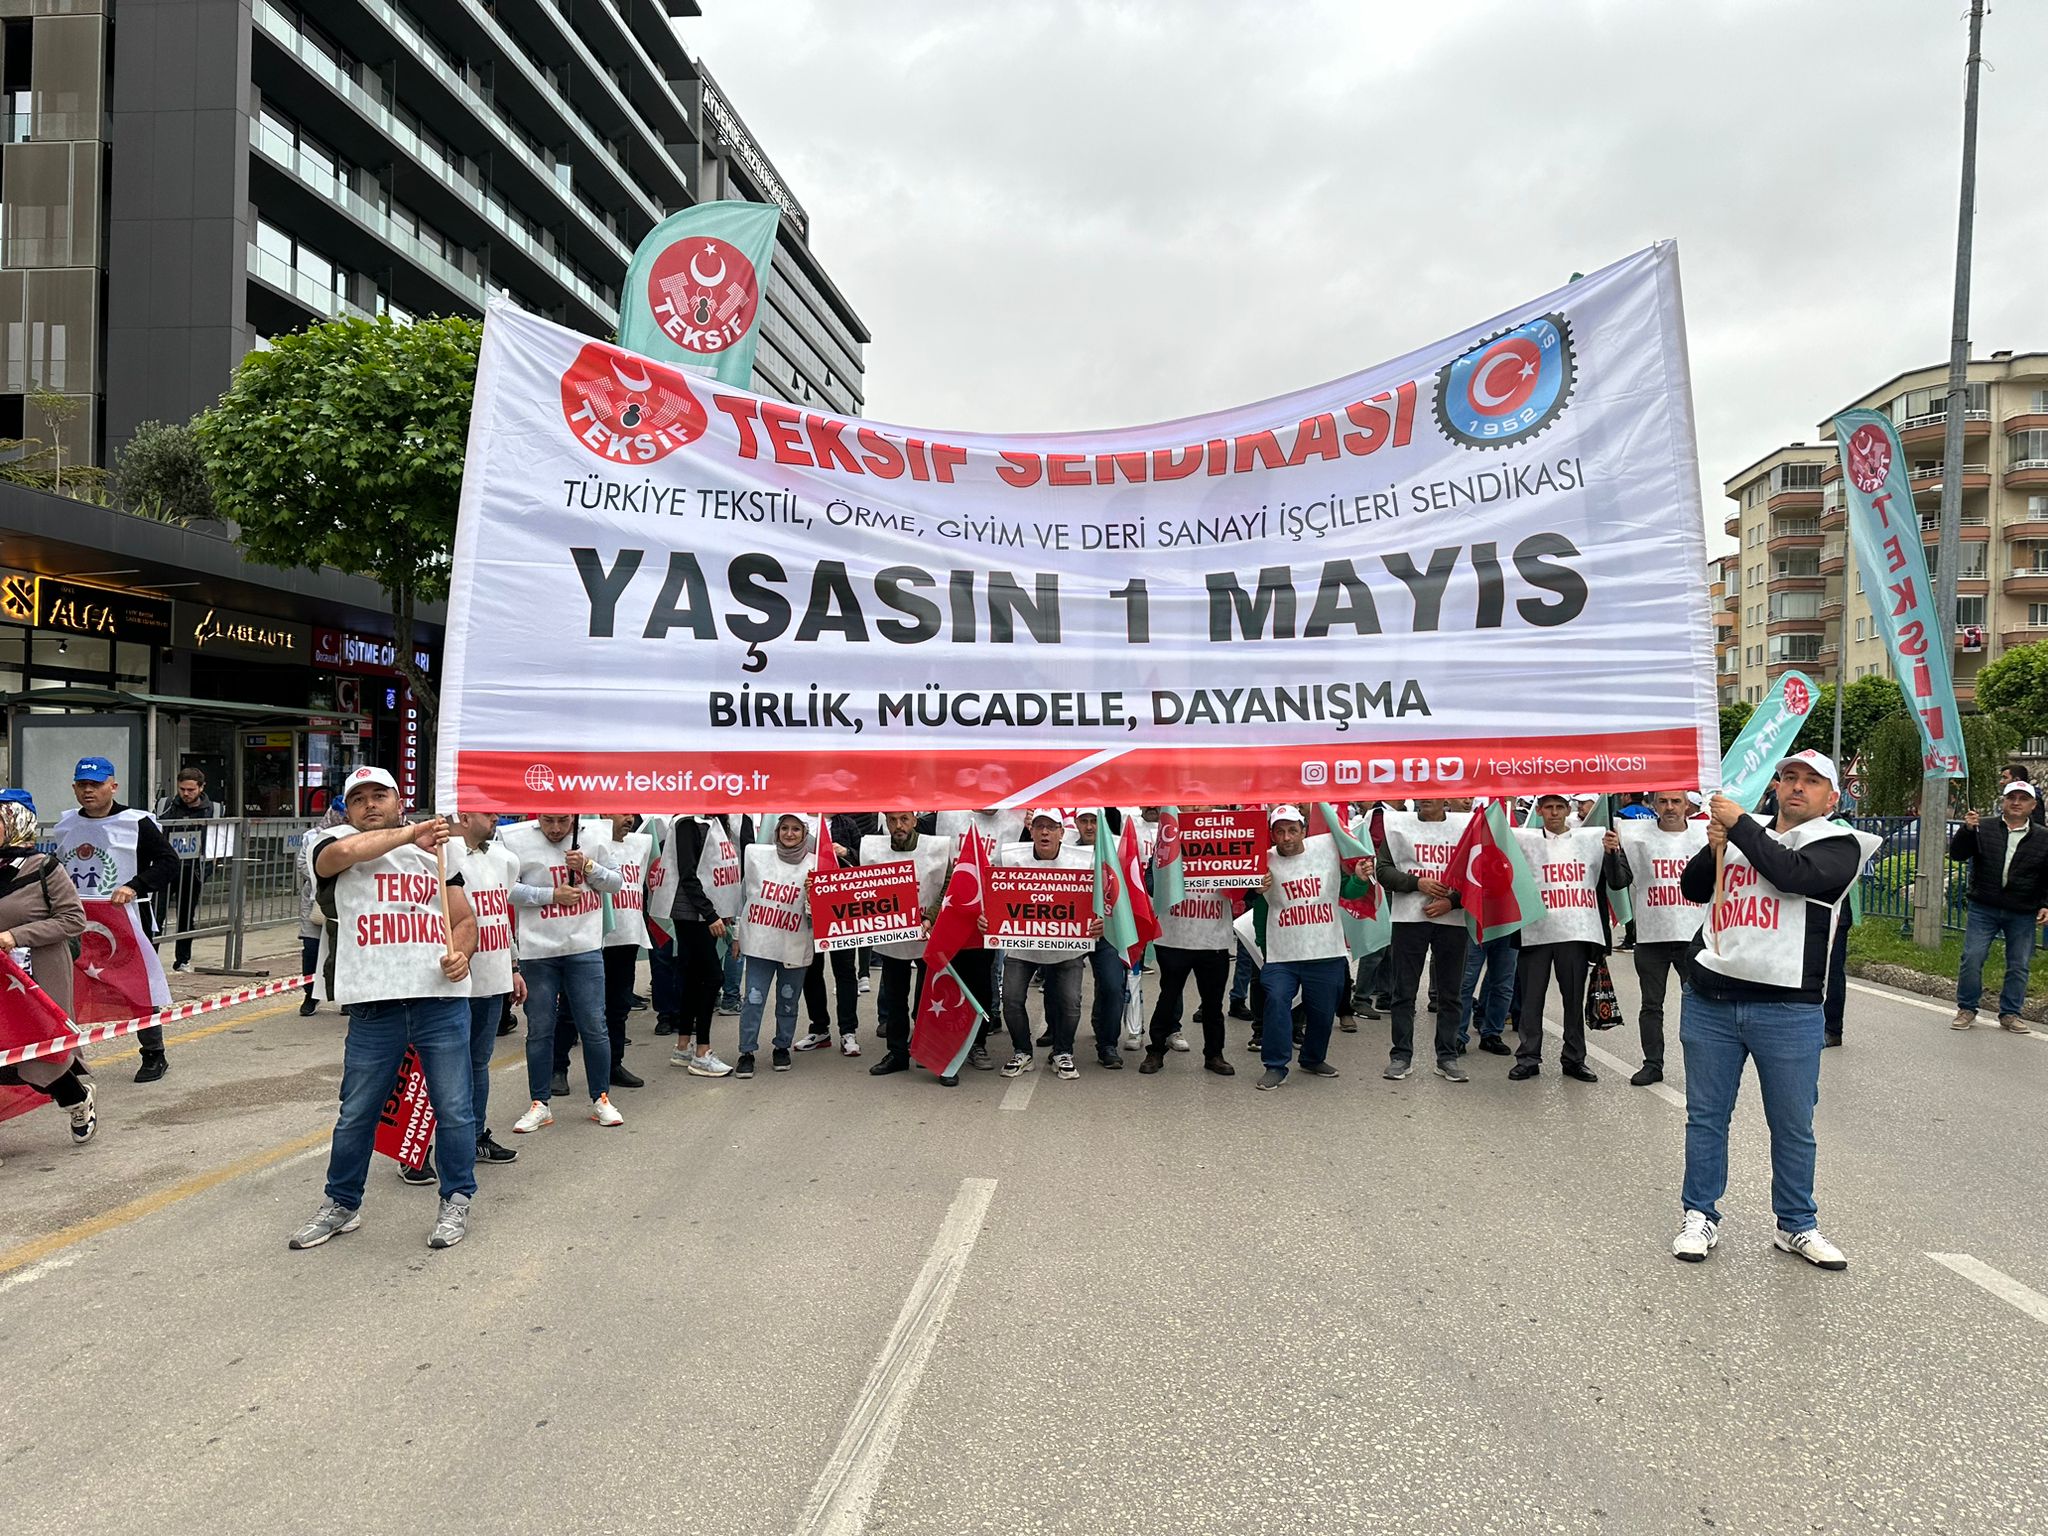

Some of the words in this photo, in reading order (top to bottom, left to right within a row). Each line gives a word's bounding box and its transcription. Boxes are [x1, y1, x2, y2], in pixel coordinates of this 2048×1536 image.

[654, 297, 742, 350] TEKSİF
[570, 399, 689, 461] TEKSİF
[1469, 407, 1537, 435] 1952
[564, 473, 686, 516] TÜRKİYE
[697, 487, 812, 530] TEKSTİL,
[826, 499, 924, 537] ÖRME,
[937, 514, 1024, 548] GİYİM
[1033, 523, 1069, 550] VE
[1081, 516, 1145, 550] DERİ
[1158, 504, 1267, 547] SANAYİ
[1280, 483, 1399, 542] İŞÇİLERİ
[1412, 457, 1585, 513] SENDİKASI
[568, 547, 1061, 673] YAŞASIN
[1109, 578, 1150, 644] 1
[1205, 532, 1589, 642] MAYIS
[709, 682, 863, 734] BİRLİK,
[878, 683, 1137, 731] MÜCADELE,
[1151, 678, 1432, 732] DAYANIŞMA
[1488, 755, 1647, 776] teksifsendikası
[557, 769, 770, 796] www.teksif.org.tr
[1194, 814, 1234, 828] GELİR
[814, 875, 829, 884] AZ
[830, 866, 896, 882] KAZANADAN
[898, 864, 913, 874] AZ
[1182, 855, 1260, 872] STİYORUZ!
[1542, 858, 1586, 883] TEKSİF
[374, 870, 439, 906] TEKSİF
[815, 885, 839, 896] ÇOK
[840, 875, 913, 891] KAZANANDAN
[991, 871, 1006, 880] AZ
[1009, 871, 1076, 882] KAZANADAN
[1079, 873, 1093, 882] AZ
[991, 882, 1015, 892] ÇOK
[1018, 883, 1093, 893] KAZANANDAN
[1184, 878, 1210, 888] EKSİF
[1282, 874, 1322, 901] TEKSİF
[762, 880, 801, 905] TEKSİF
[853, 889, 877, 901] ÇOK
[1030, 893, 1054, 904] ÇOK
[1540, 884, 1597, 910] ENDİKASI
[748, 903, 801, 934] SENDİKASI
[832, 894, 899, 919] VERGİ
[1007, 901, 1075, 920] VERGİ
[1278, 899, 1334, 928] SENDİKASI
[357, 906, 447, 947] SENDİKAS
[827, 912, 907, 937] ALINSIN
[999, 919, 1081, 937] ALINSIN
[831, 937, 865, 949] TEKSİF
[867, 930, 919, 943] SENDİKASI
[1000, 938, 1035, 948] TEKSİF
[1037, 939, 1091, 950] SENDİKASI
[404, 1071, 421, 1104] ÇOK
